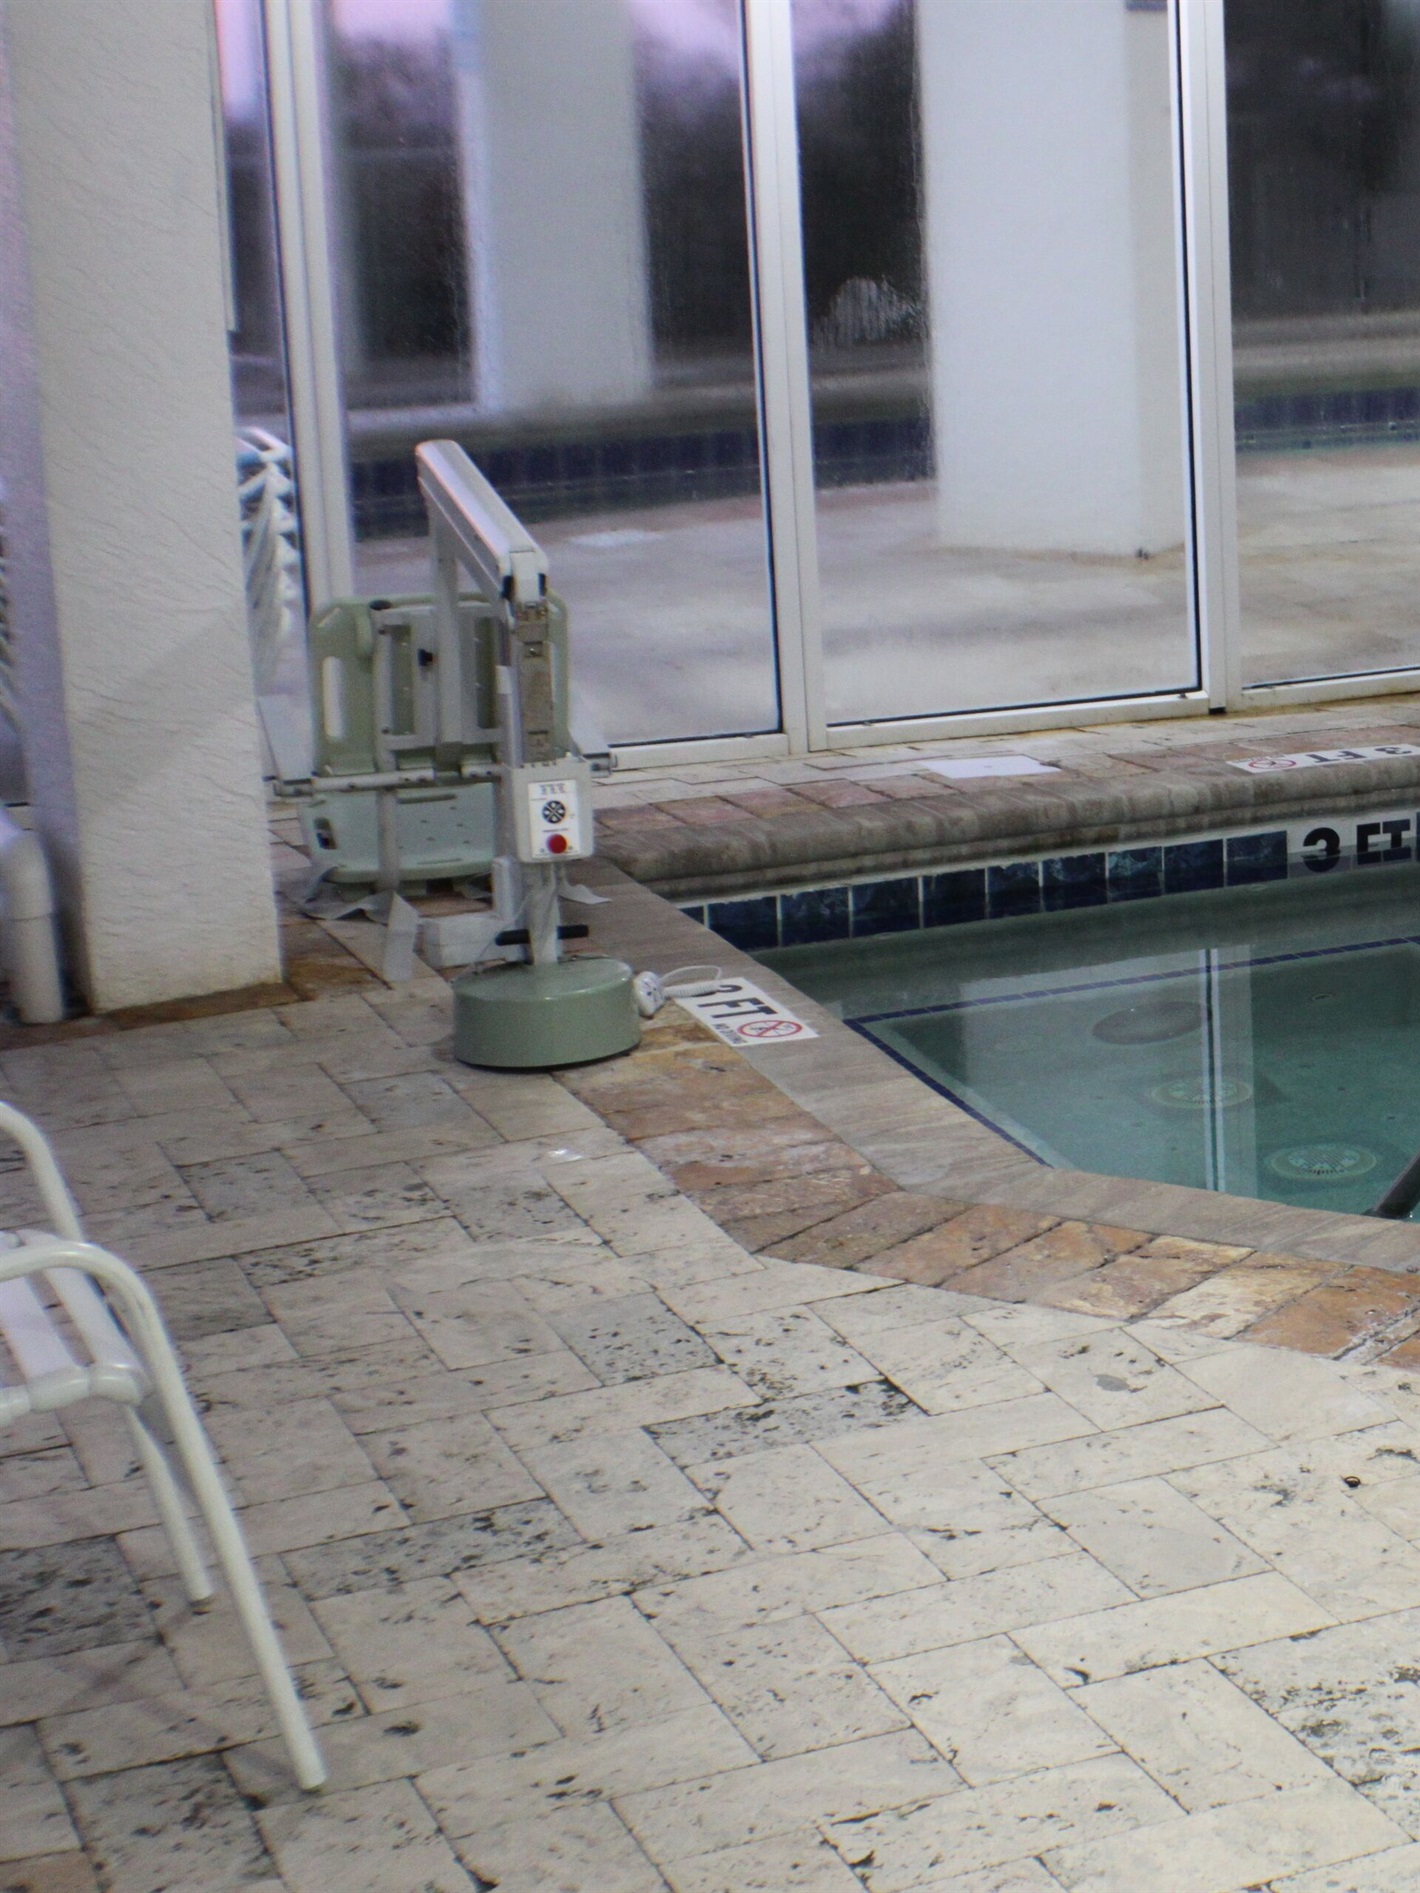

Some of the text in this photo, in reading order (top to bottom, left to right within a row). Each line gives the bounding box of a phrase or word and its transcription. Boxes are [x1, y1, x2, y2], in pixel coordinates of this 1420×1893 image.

[1305, 746, 1413, 763] 3 FT
[697, 997, 778, 1018] FT
